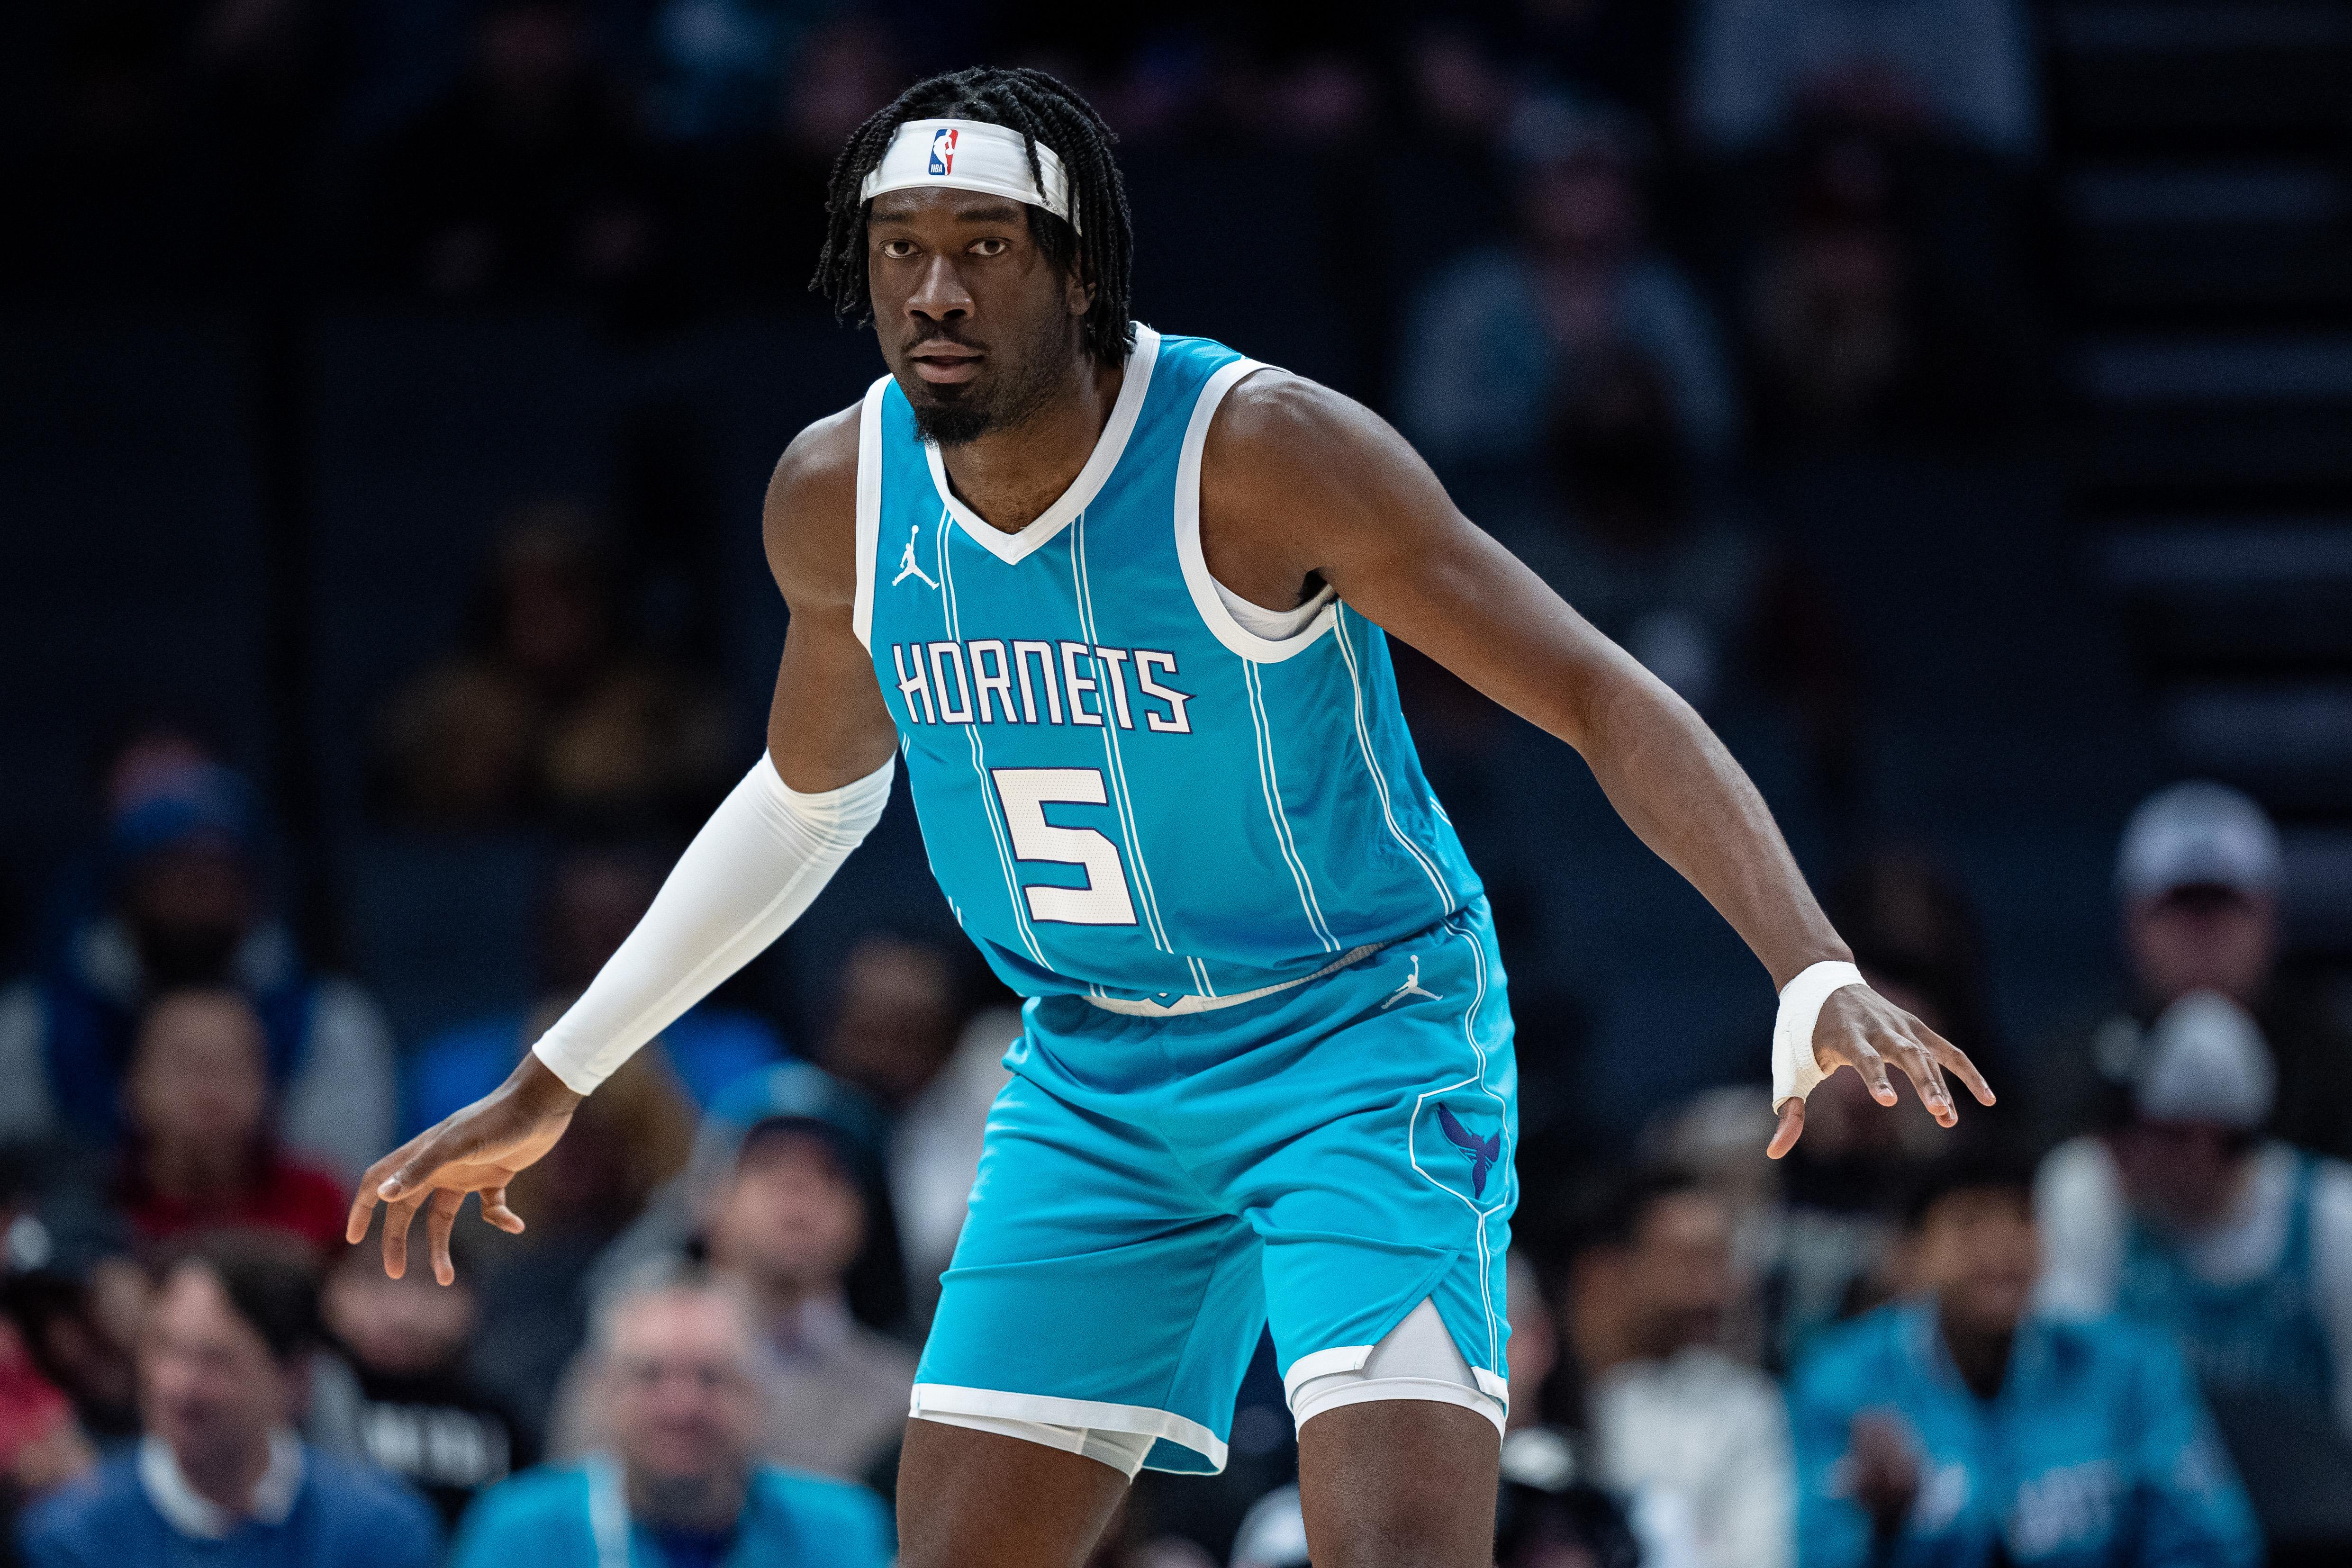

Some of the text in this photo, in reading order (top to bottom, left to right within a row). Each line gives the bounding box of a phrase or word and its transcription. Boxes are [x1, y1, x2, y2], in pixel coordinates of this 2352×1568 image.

[931, 164, 942, 172] NBA
[892, 638, 1196, 734] HORNETS
[989, 766, 1140, 926] 5
